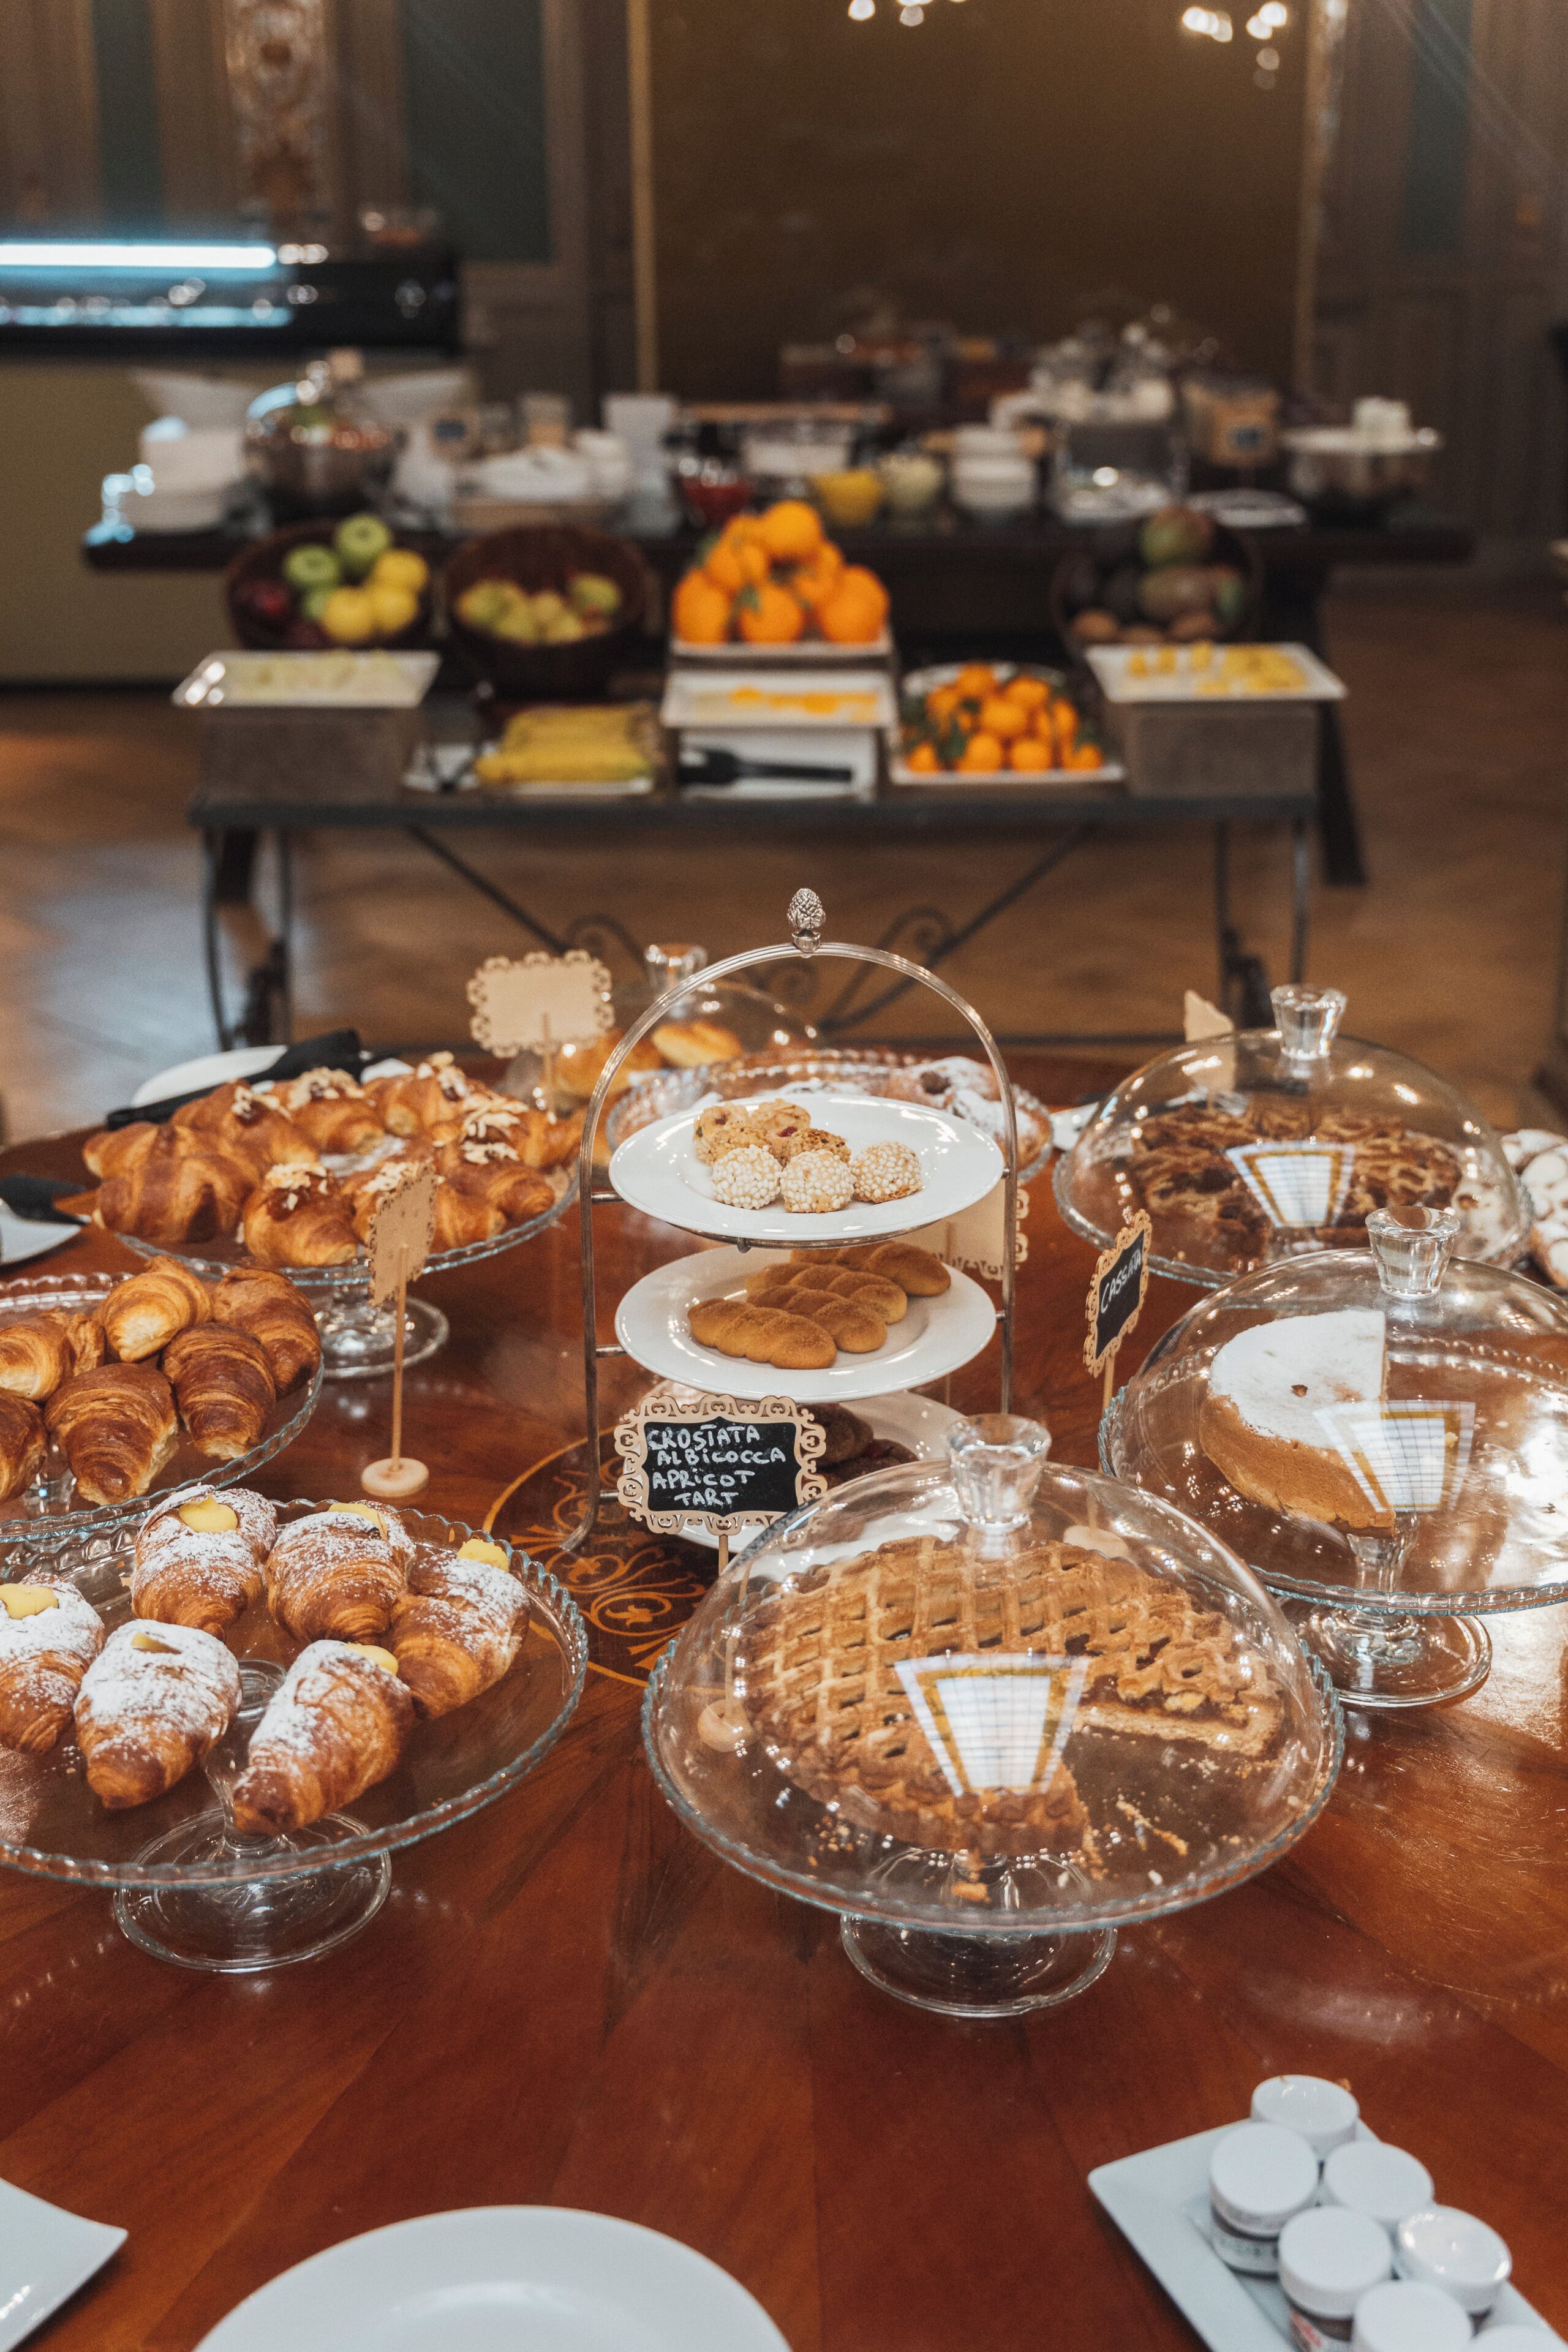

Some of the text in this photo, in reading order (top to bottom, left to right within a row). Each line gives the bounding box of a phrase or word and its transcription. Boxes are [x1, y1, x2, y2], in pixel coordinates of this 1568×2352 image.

[1101, 1248, 1142, 1314] CASSATA
[647, 1424, 760, 1451] CROSTATA
[674, 1488, 739, 1507] TART
